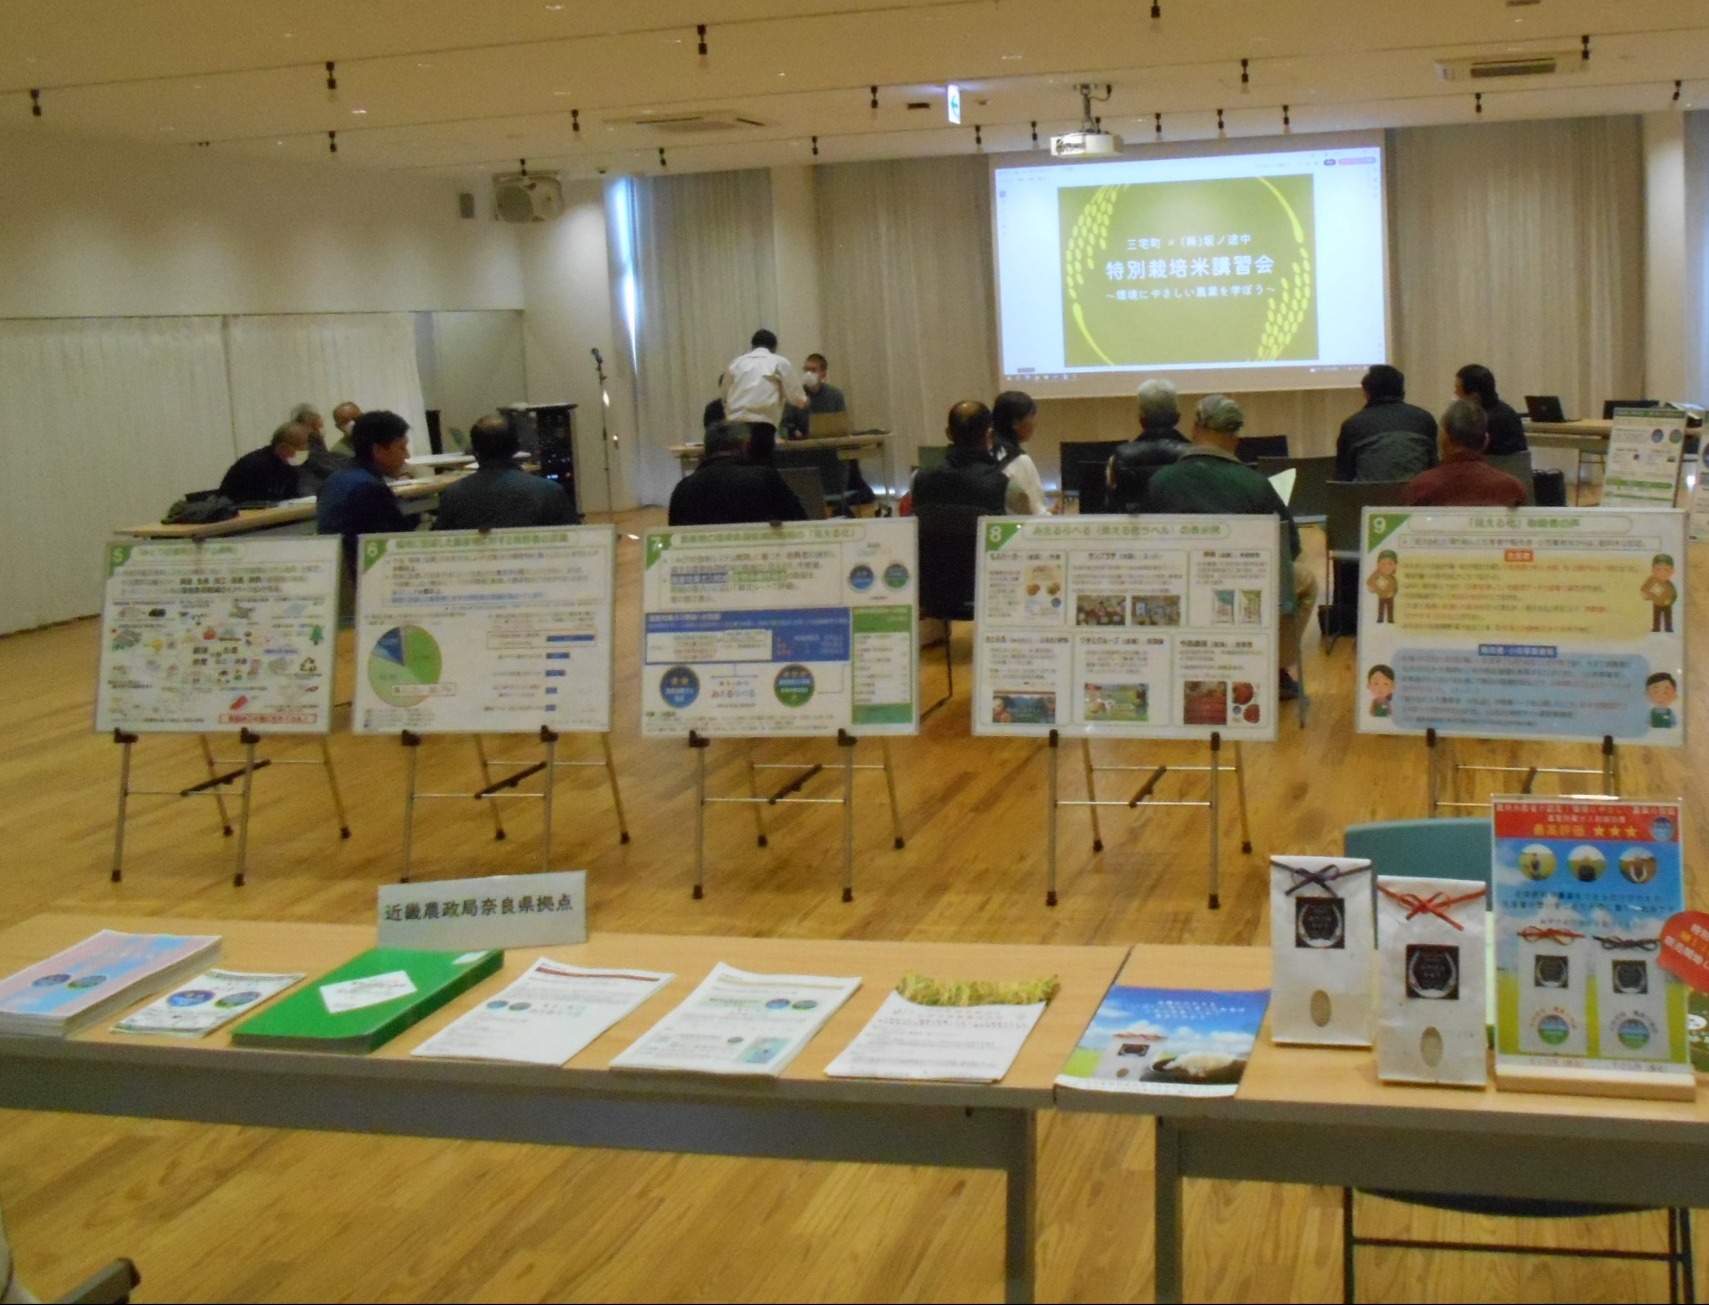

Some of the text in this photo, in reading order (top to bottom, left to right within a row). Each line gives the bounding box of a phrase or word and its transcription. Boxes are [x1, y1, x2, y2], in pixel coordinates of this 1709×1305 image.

[1105, 254, 1275, 281] 特別栽培米講習会
[989, 525, 1003, 543] 8
[1372, 517, 1387, 534] 9
[384, 893, 574, 922] 近畿農政局奈良県拠点
